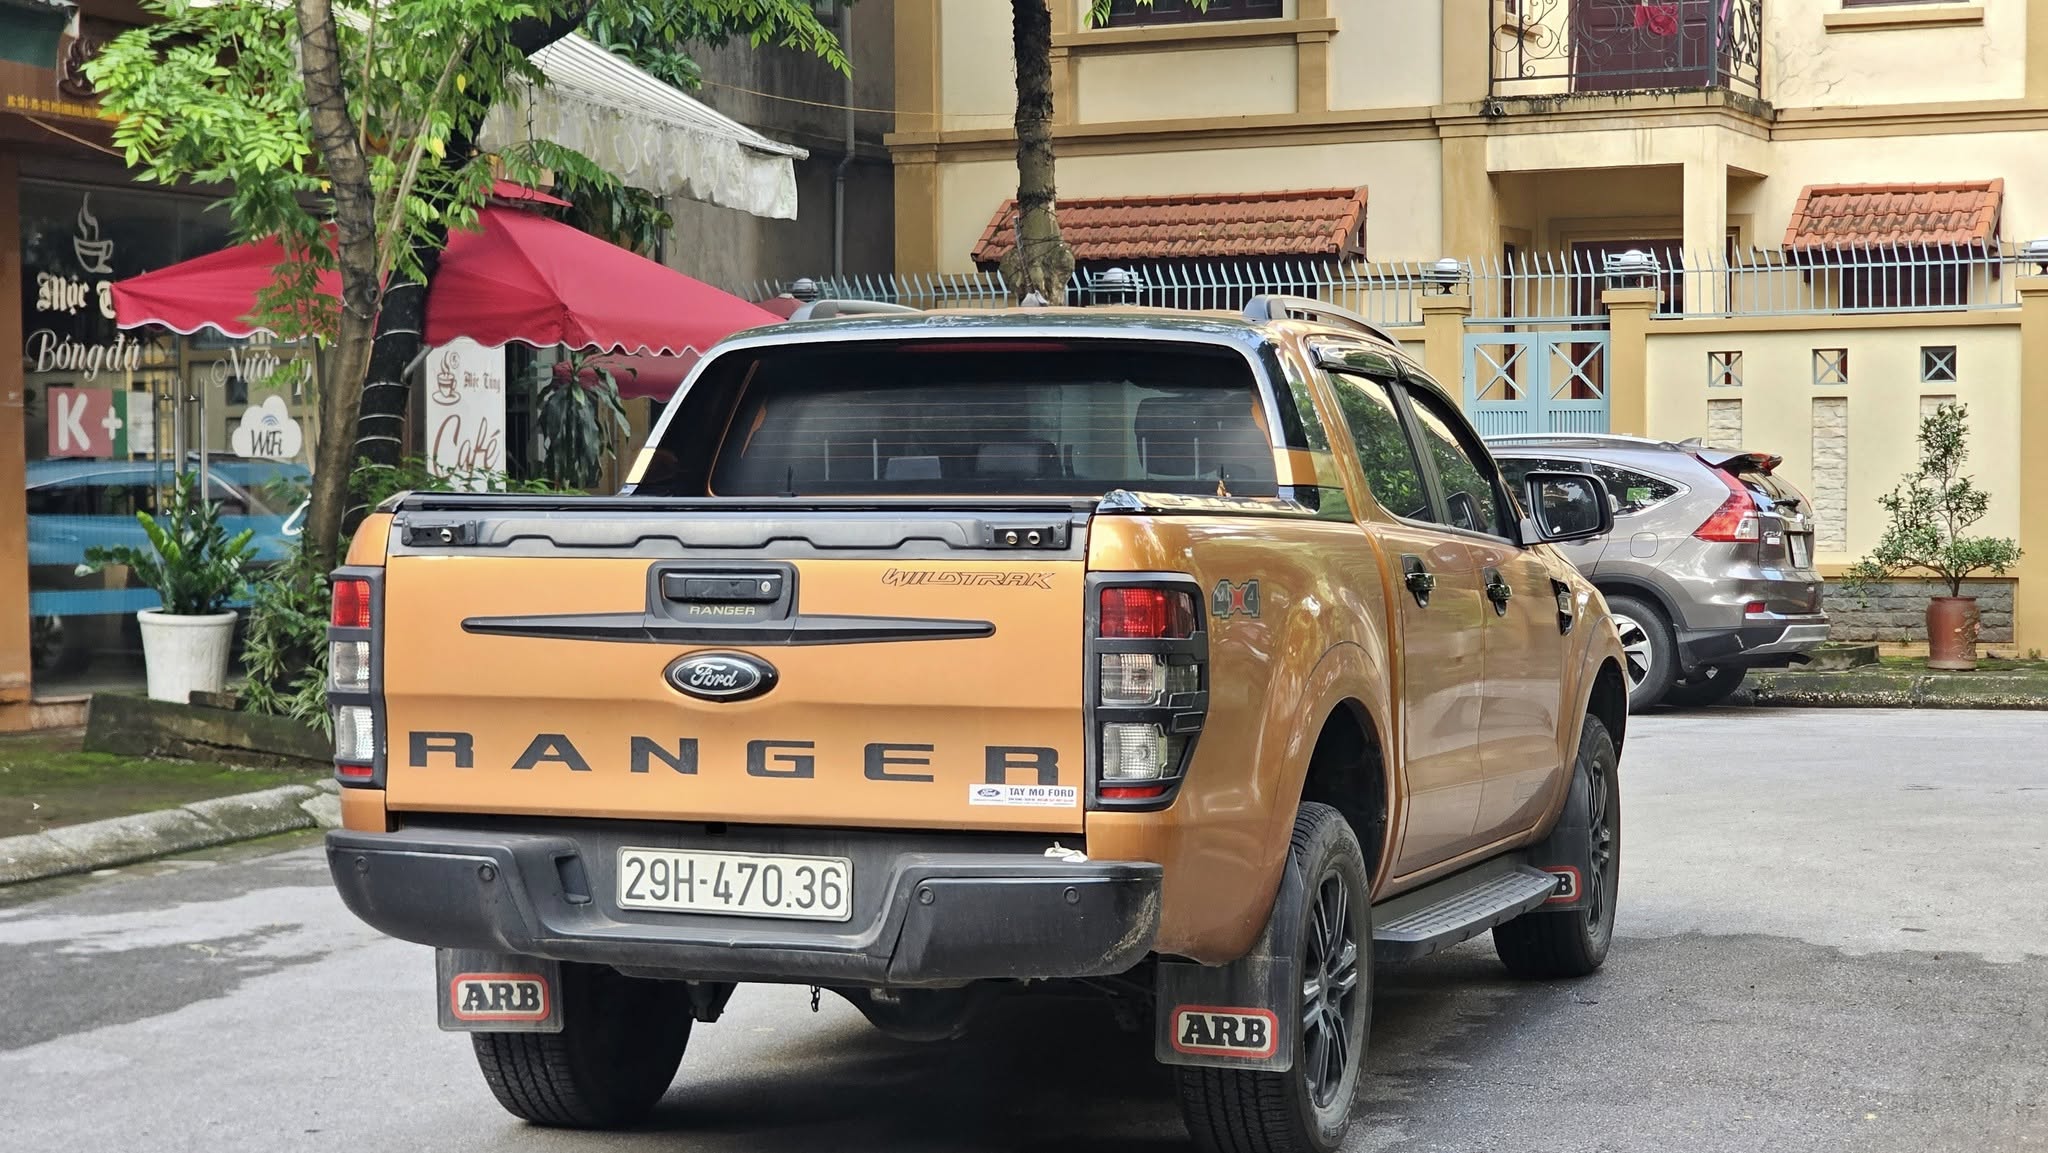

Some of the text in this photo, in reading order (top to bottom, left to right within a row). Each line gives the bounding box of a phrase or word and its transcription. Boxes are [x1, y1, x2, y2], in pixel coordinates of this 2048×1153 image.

[26, 328, 142, 382] Bóng đá
[251, 429, 283, 456] WiFi
[432, 414, 501, 492] Café
[881, 568, 1056, 590] WILDTRAK
[689, 605, 756, 617] RANGER
[690, 662, 738, 689] Ford
[408, 730, 1059, 786] RANGER
[1009, 787, 1026, 796] TAY
[1048, 788, 1074, 798] FORD
[624, 856, 843, 911] 29H-470.36
[462, 982, 540, 1011] ARB
[1181, 1013, 1267, 1048] ARB
